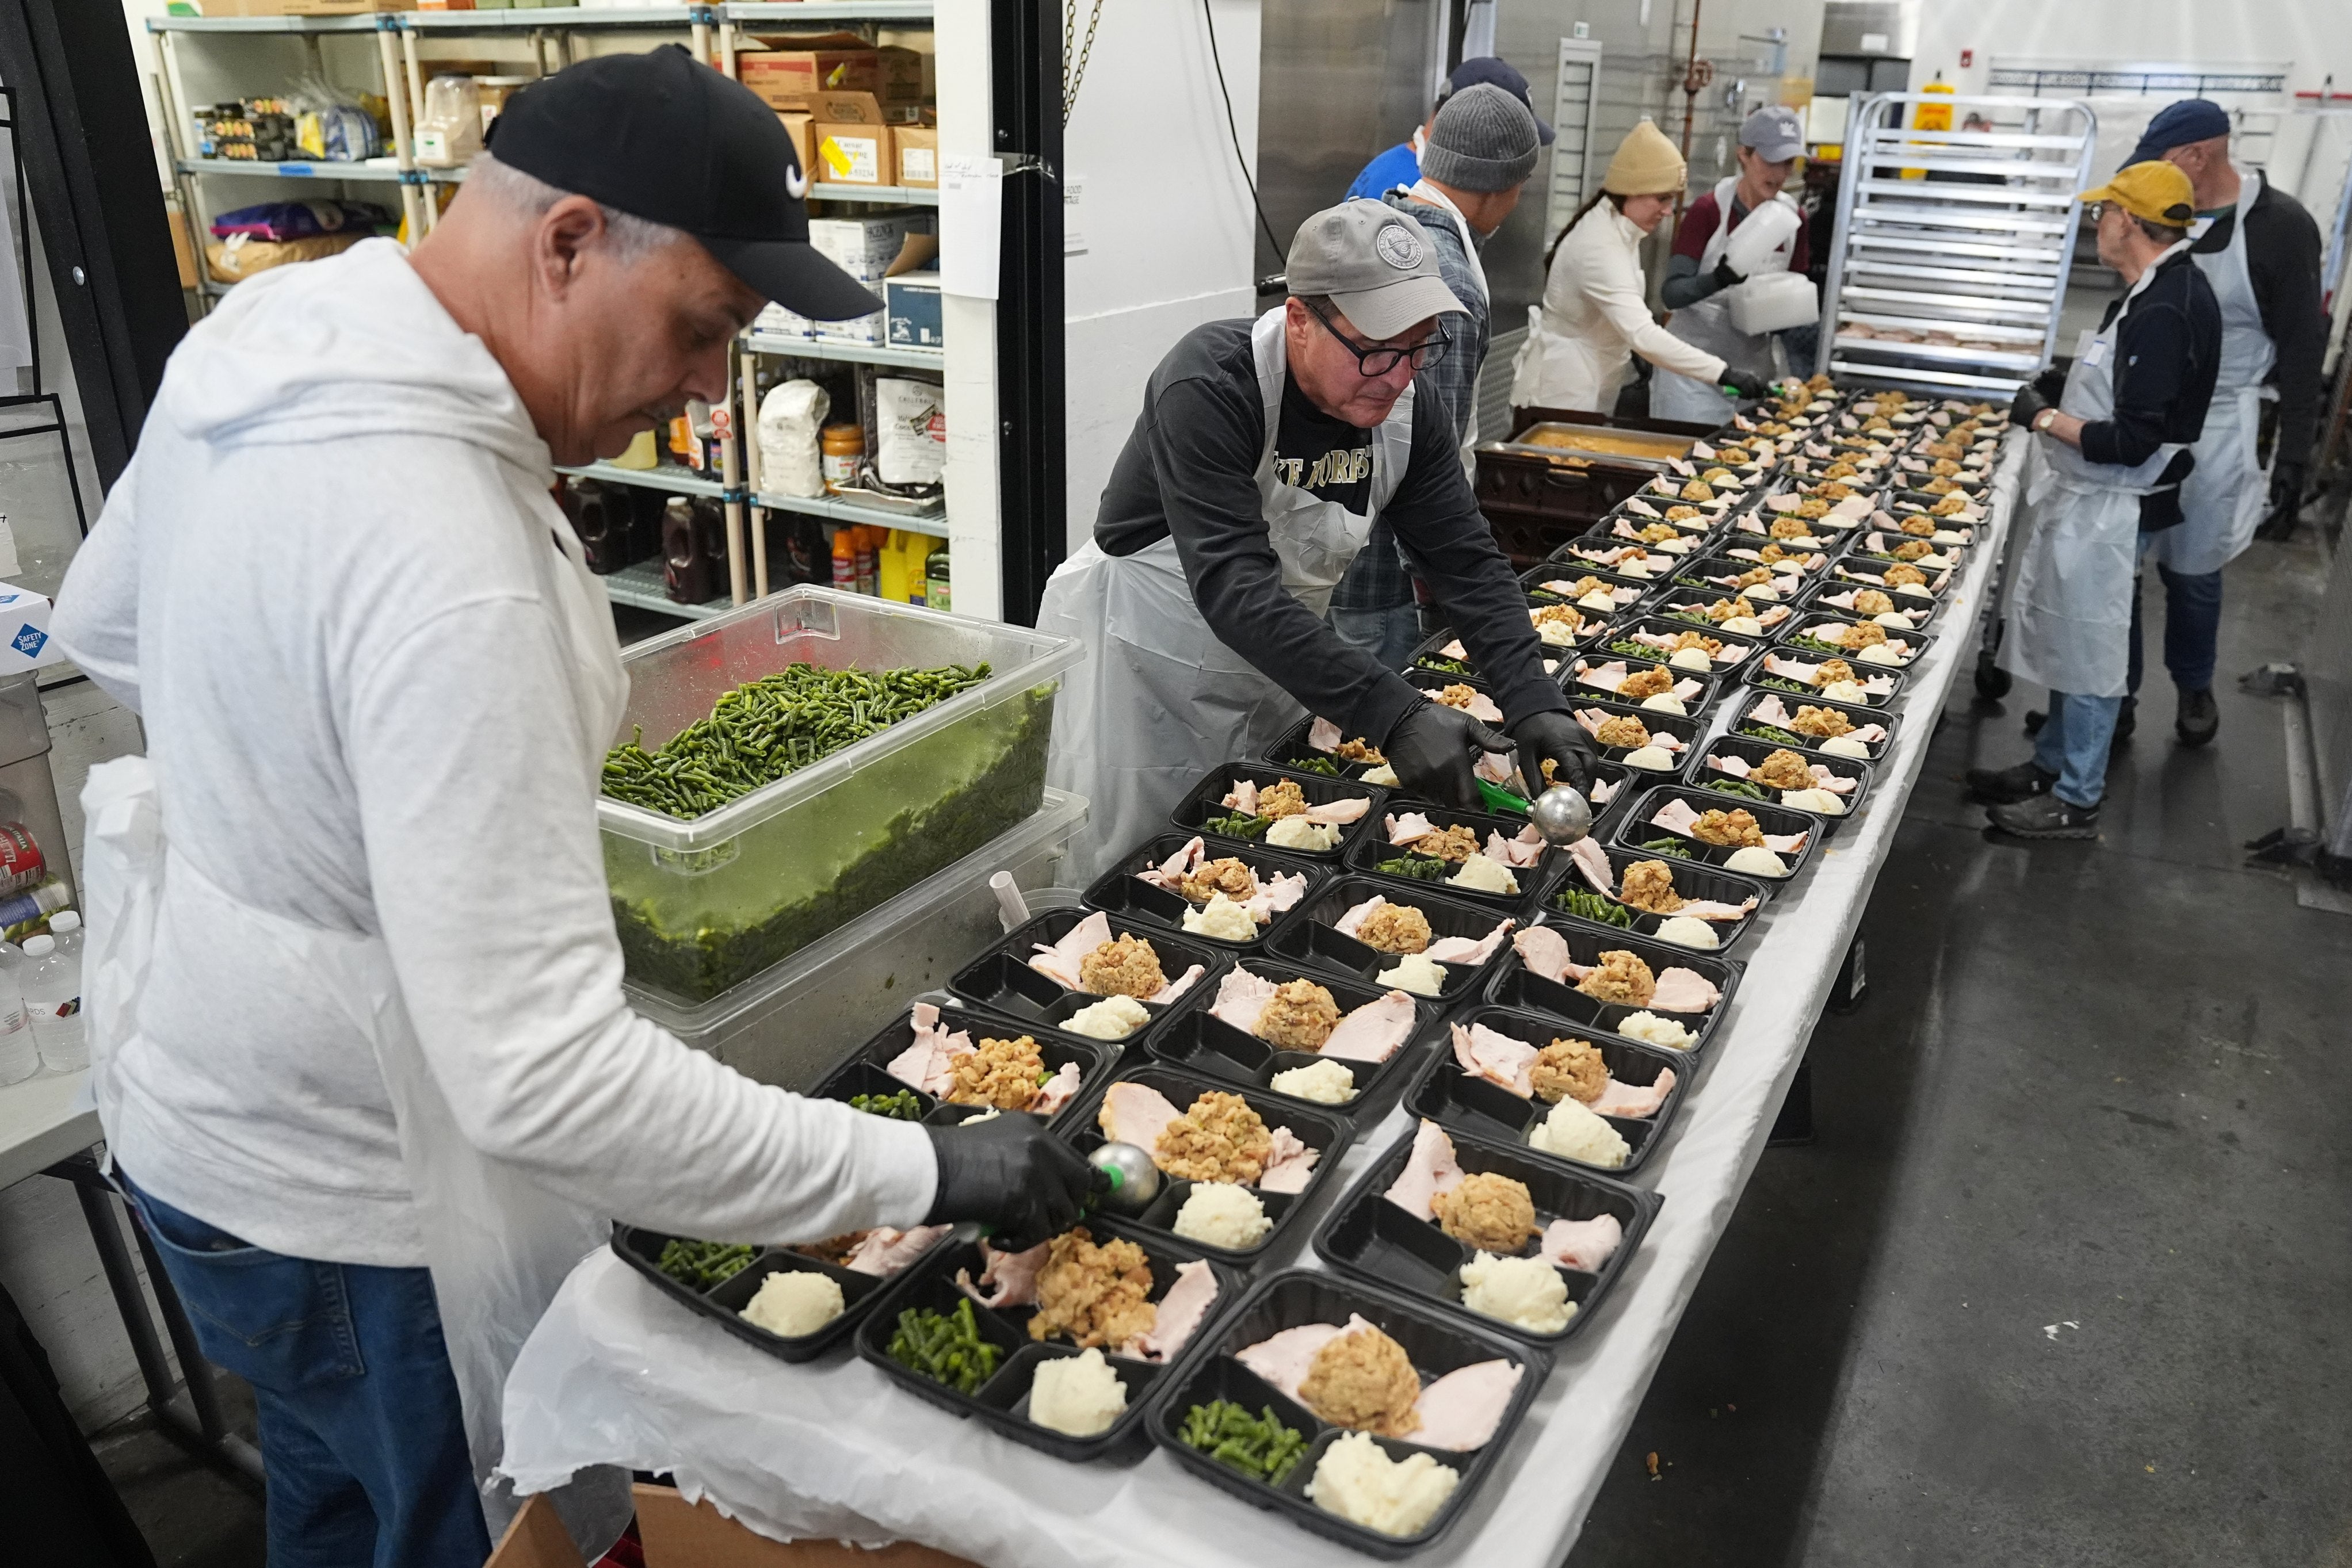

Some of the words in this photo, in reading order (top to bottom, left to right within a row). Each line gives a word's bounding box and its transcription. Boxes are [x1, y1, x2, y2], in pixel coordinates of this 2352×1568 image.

[1273, 450, 1304, 487] KE
[1302, 445, 1375, 489] FORES
[18, 632, 42, 644] SAFETY
[20, 640, 38, 651] ZONE
